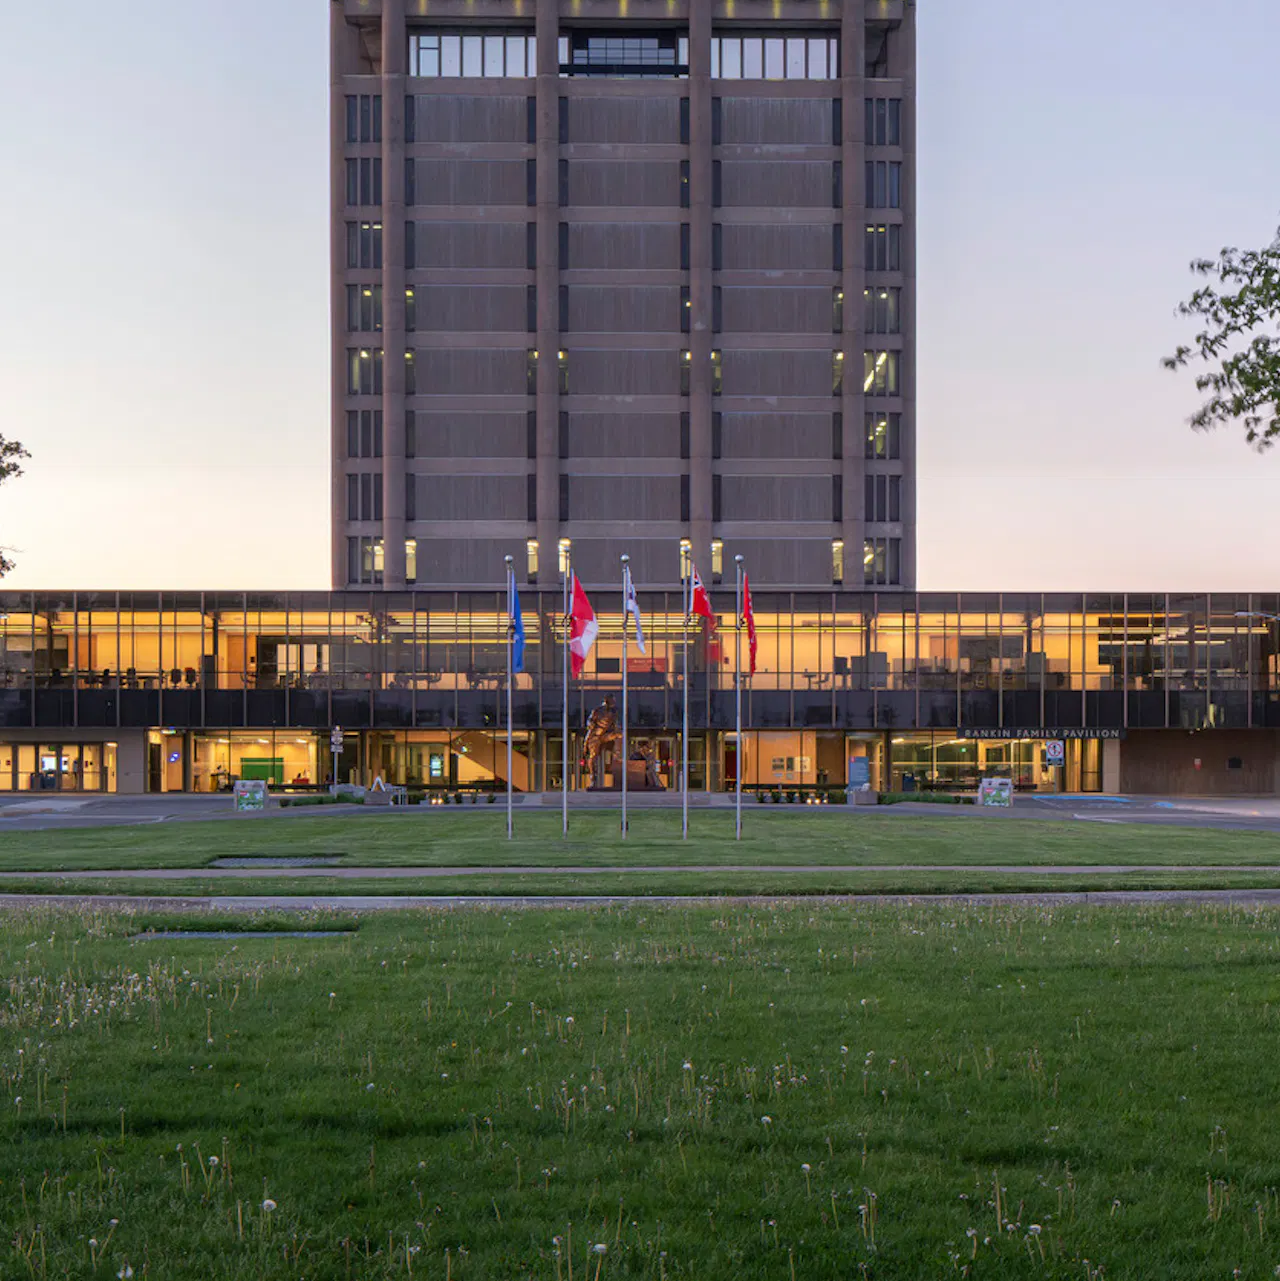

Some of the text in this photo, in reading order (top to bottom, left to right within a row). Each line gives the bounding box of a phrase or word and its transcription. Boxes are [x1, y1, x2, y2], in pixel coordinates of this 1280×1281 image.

[964, 729, 1119, 738] RANKIN FAMILY PAVILION
